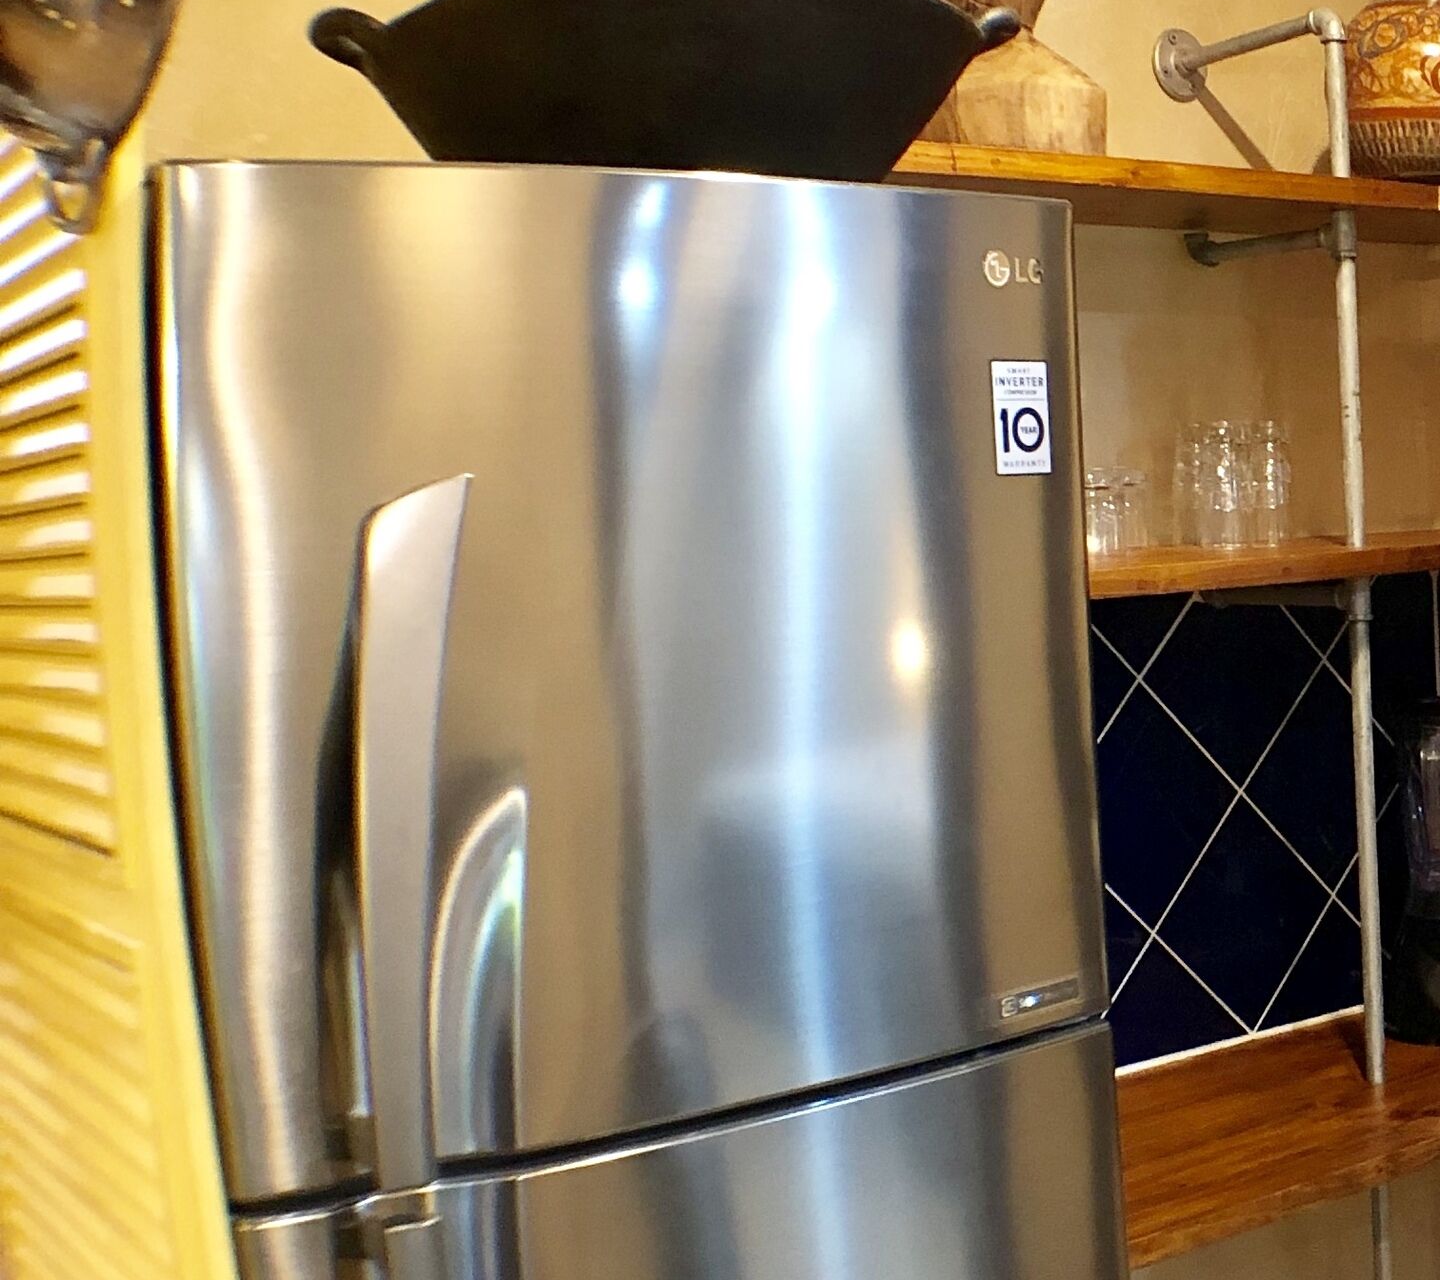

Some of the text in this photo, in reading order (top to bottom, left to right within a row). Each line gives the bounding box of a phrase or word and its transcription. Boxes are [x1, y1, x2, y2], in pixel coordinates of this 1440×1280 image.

[1014, 257, 1044, 285] LG
[995, 376, 1044, 388] INVERTER
[1000, 407, 1045, 453] 10
